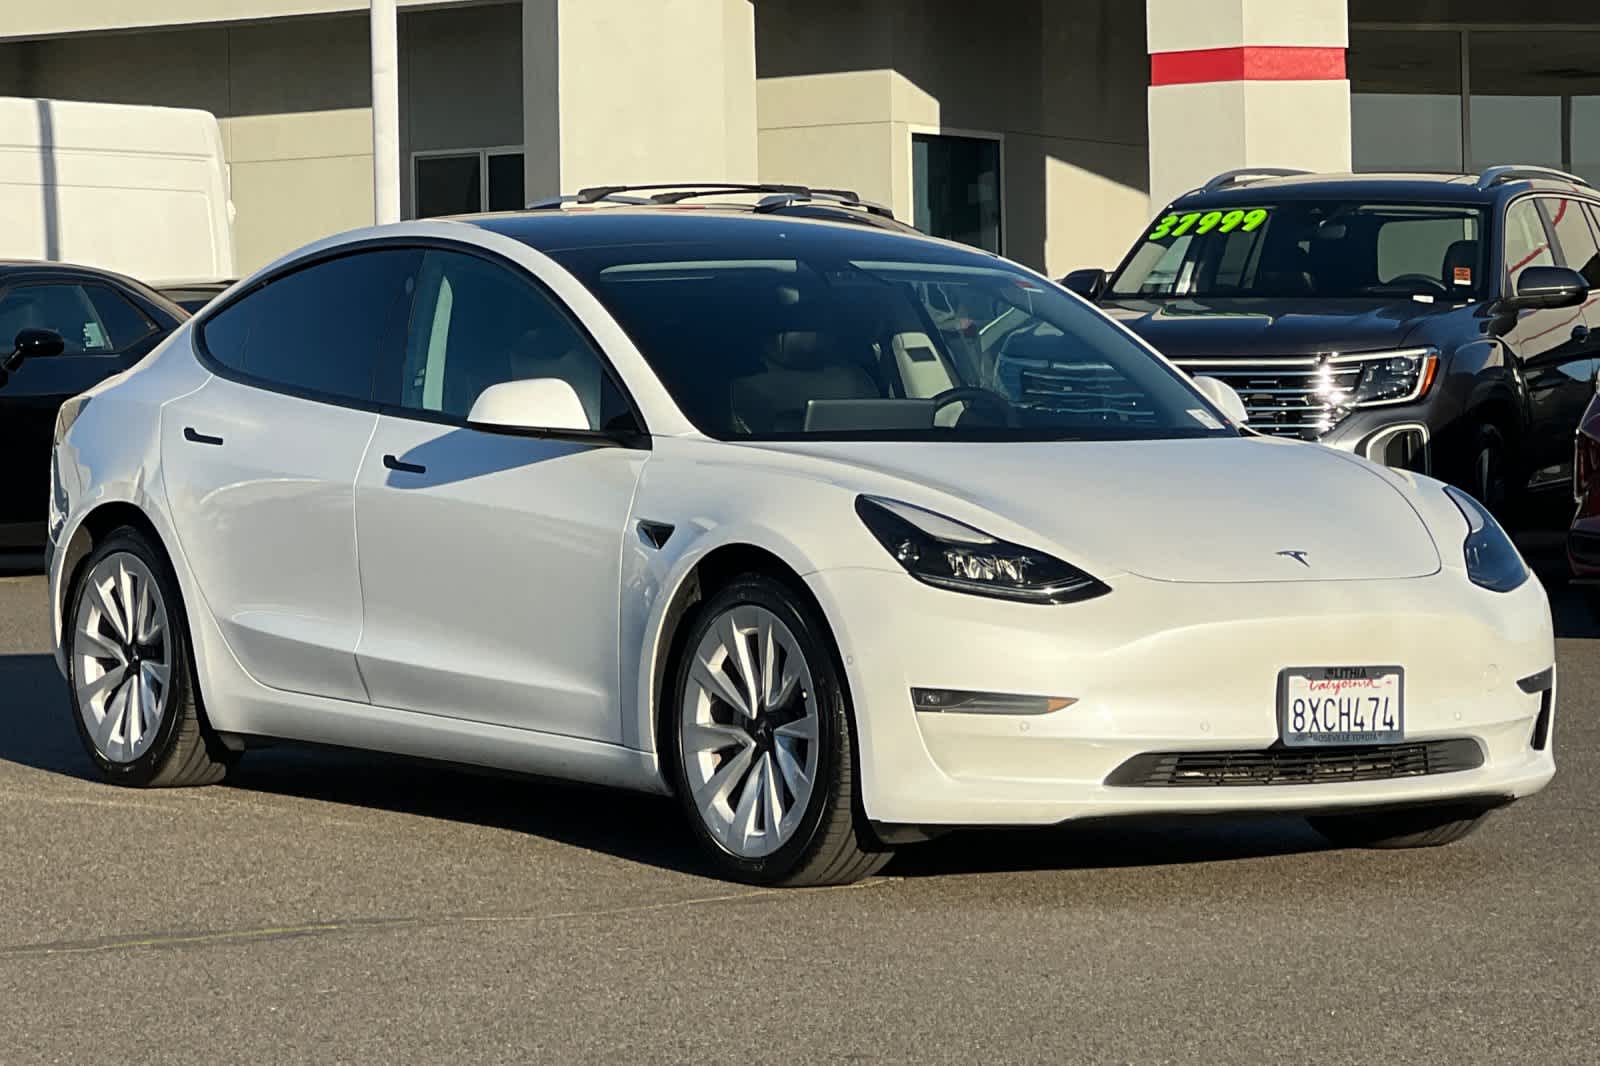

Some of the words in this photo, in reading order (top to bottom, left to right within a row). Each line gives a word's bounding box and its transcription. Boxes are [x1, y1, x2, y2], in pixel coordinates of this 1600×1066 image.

[1148, 208, 1268, 240] 37999
[1334, 666, 1367, 679] LITHIA
[1292, 697, 1395, 733] 8XCH474
